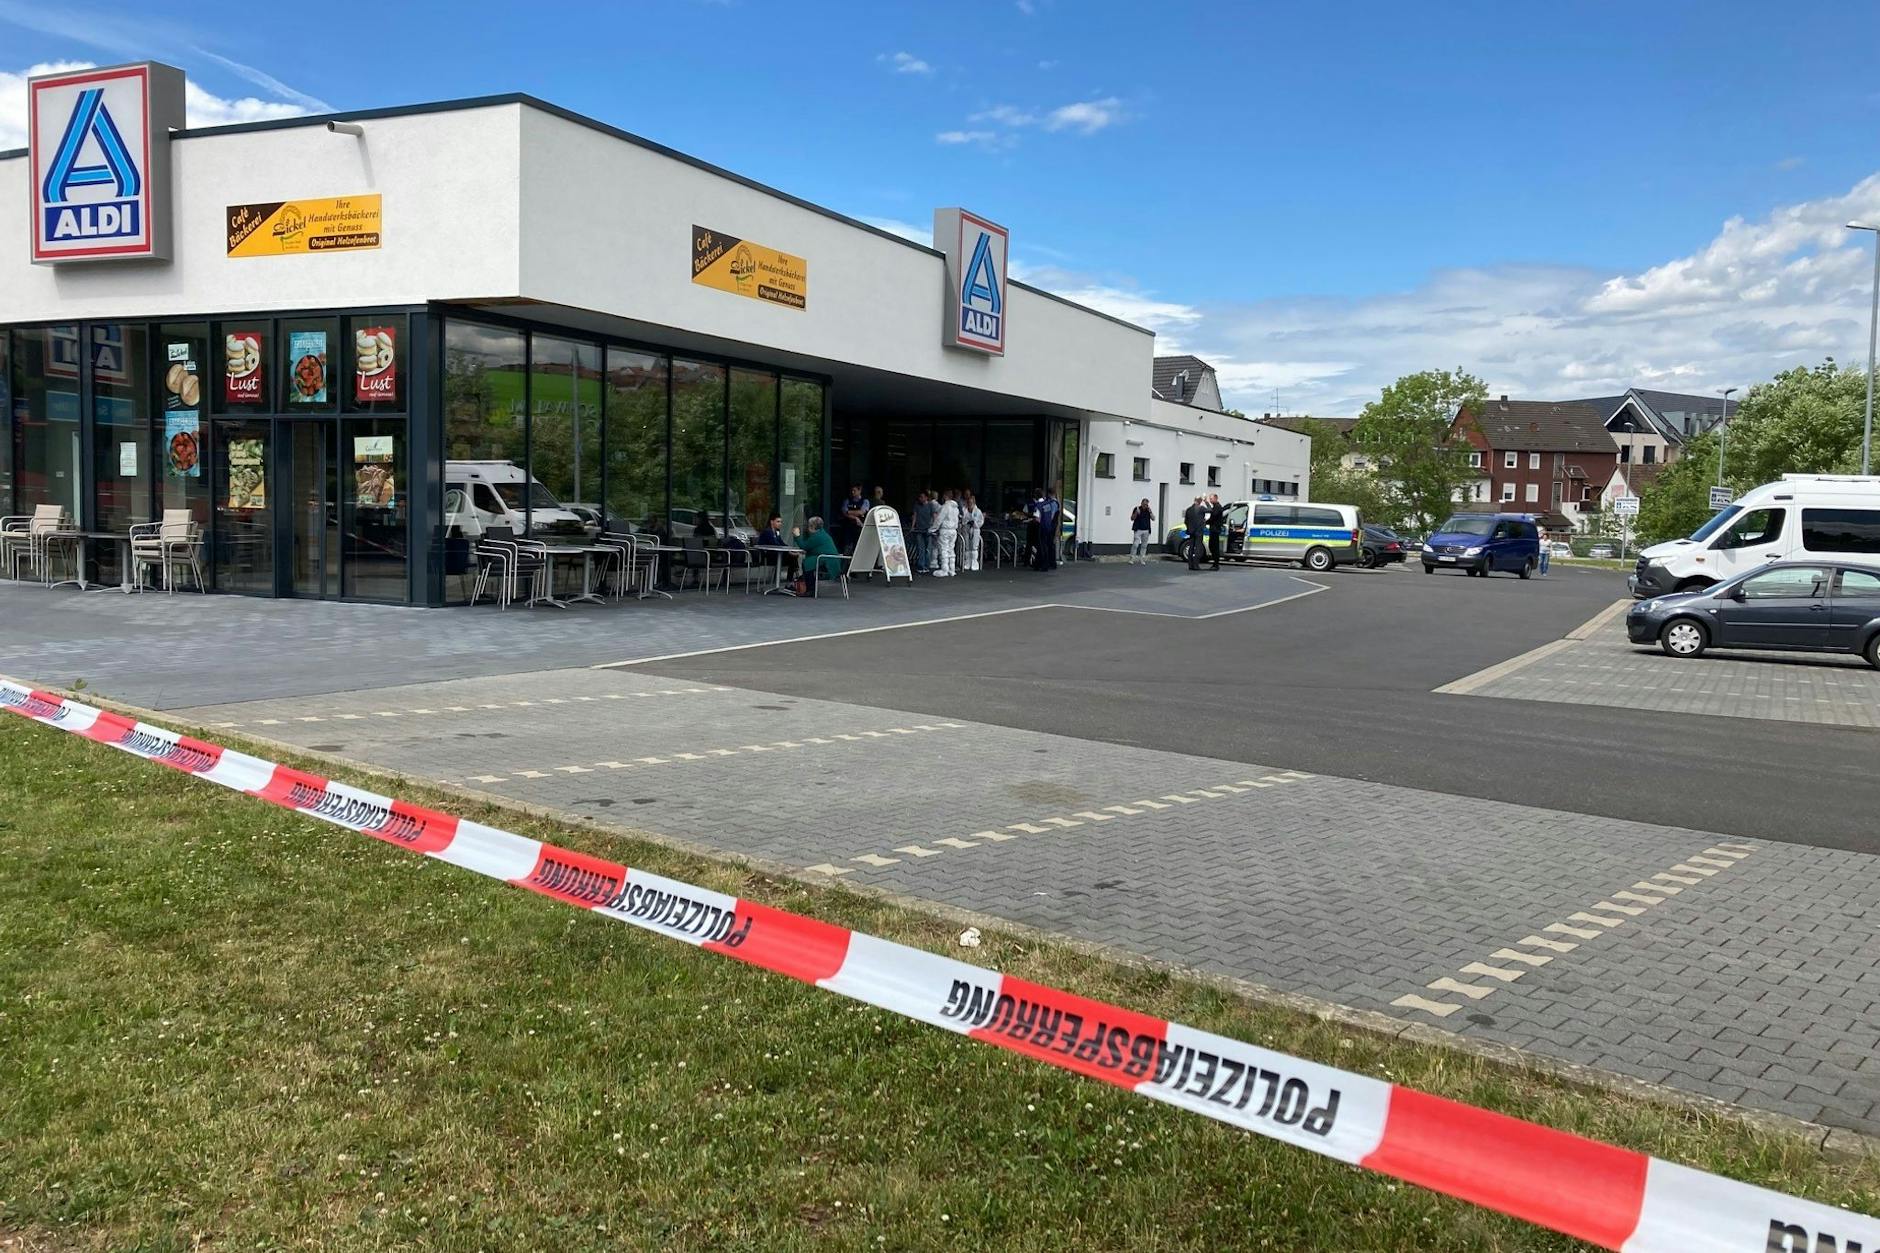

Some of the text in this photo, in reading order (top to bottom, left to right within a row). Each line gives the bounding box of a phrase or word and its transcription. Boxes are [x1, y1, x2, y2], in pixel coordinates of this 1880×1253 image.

[336, 199, 351, 209] Ihre
[53, 204, 131, 239] ALDI
[231, 206, 249, 228] Café
[308, 208, 380, 223] Handwerksbäckerei
[229, 211, 262, 248] Bäckerei
[323, 222, 363, 233] mit Genuss
[311, 236, 337, 249] Original
[694, 241, 723, 272] Bäckerei
[965, 311, 996, 338] ALDI
[229, 371, 260, 391] Lust
[360, 370, 394, 391] Lust
[1260, 529, 1290, 537] POLIZEI
[288, 782, 427, 842] POLIZEIABSPERRUNG
[534, 858, 753, 948] POLIZEIABSPERRUNG
[939, 979, 1341, 1137] POLIZEIABSPERRUNG
